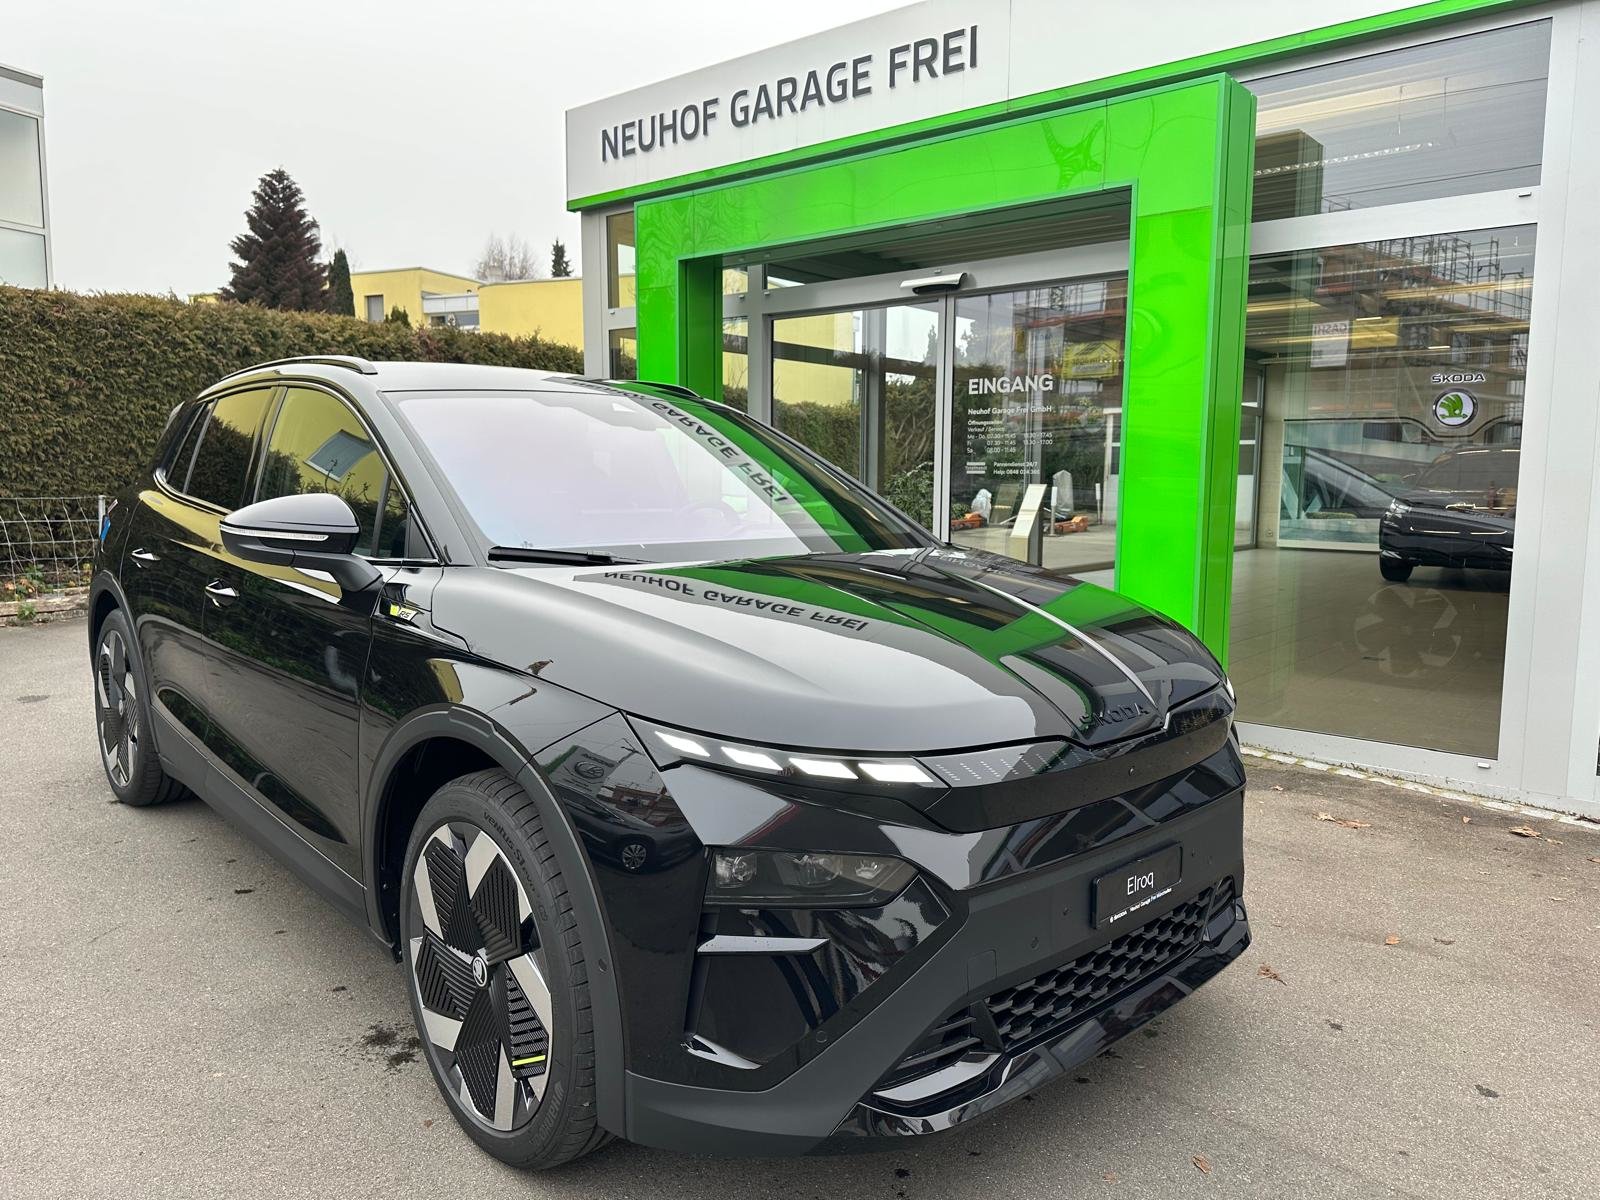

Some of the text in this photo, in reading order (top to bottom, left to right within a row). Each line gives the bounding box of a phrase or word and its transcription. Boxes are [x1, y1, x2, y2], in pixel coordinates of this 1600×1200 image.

[601, 25, 979, 162] NEUHOF GARAGE FREI
[968, 374, 1053, 395] EINGANG
[1431, 373, 1486, 384] ŠKODA
[967, 407, 991, 415] Neuhof
[992, 407, 1015, 416] Garage
[1030, 405, 1052, 413] GmbH
[1127, 871, 1154, 896] Elroq
